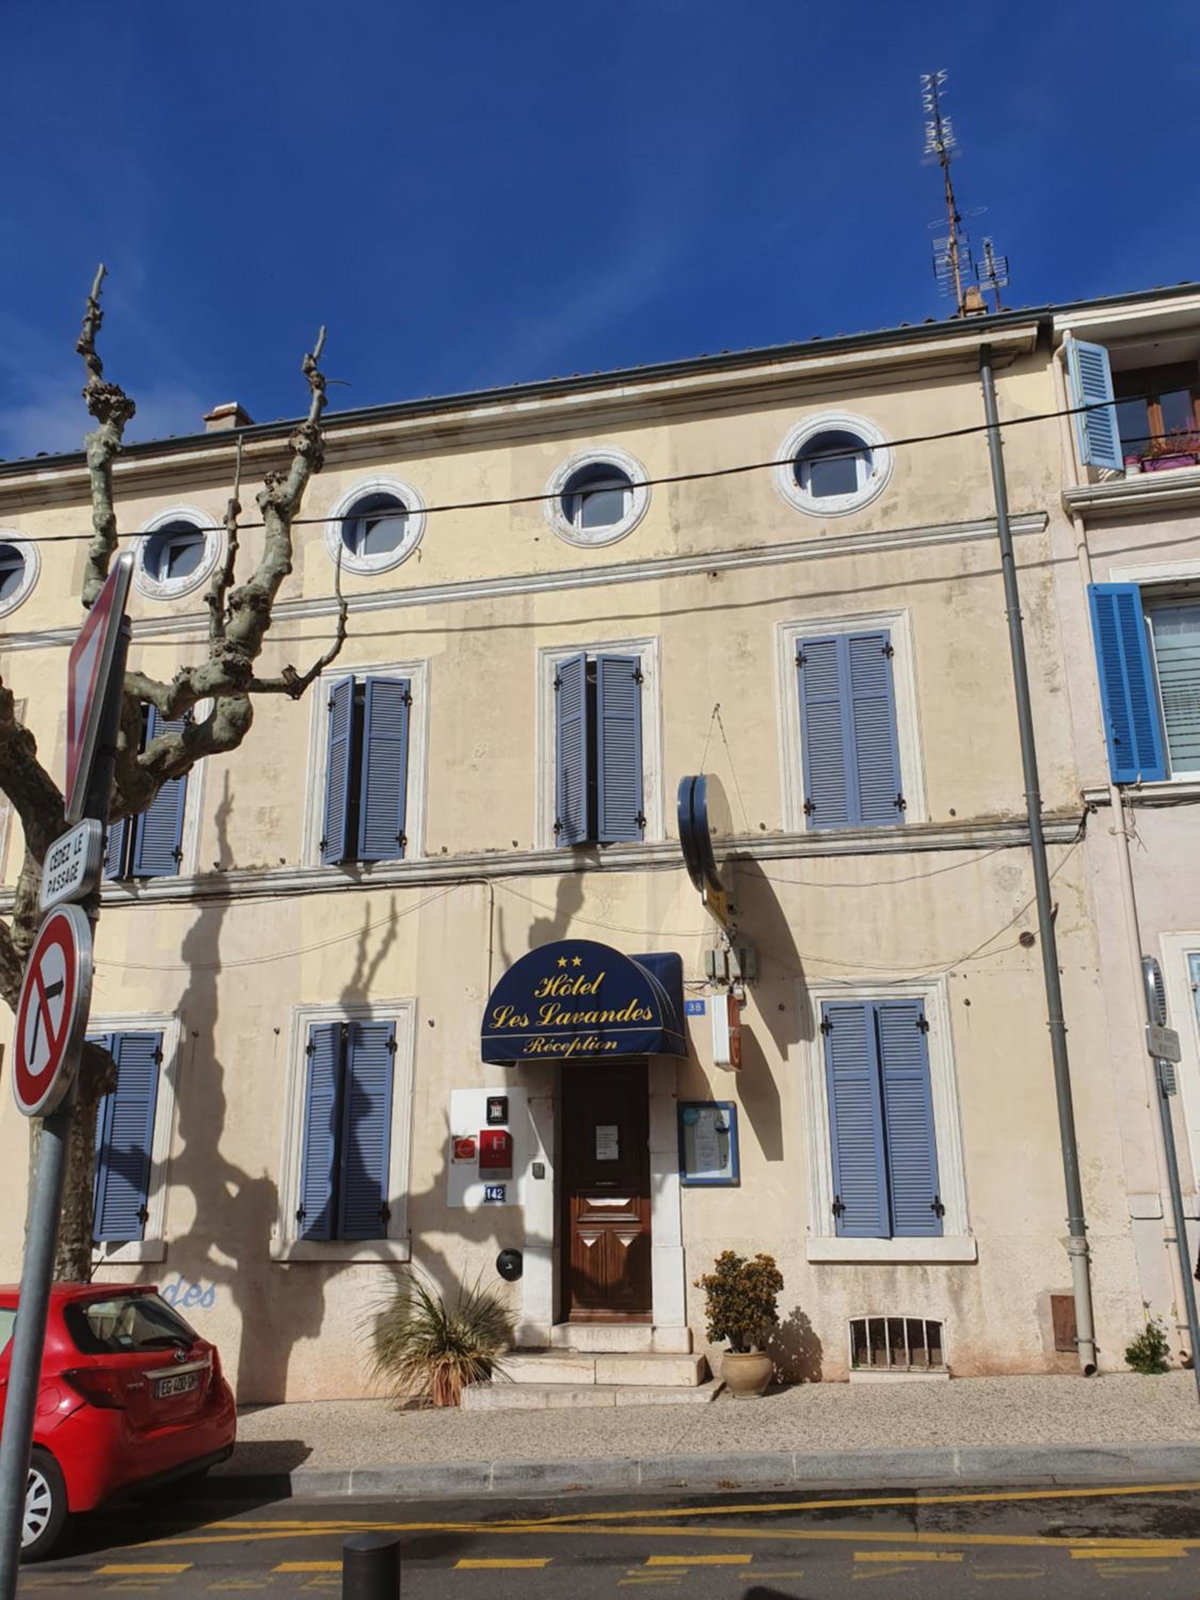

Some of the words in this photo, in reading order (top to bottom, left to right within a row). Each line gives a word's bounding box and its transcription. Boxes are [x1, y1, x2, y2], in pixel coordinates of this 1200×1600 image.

[73, 832, 83, 856] LE
[47, 860, 80, 897] PASSAGE
[534, 972, 605, 998] Hôtel
[488, 1005, 529, 1029] Les
[535, 998, 653, 1027] Lavandes
[523, 1036, 617, 1058] Réception
[486, 1188, 503, 1199] 142
